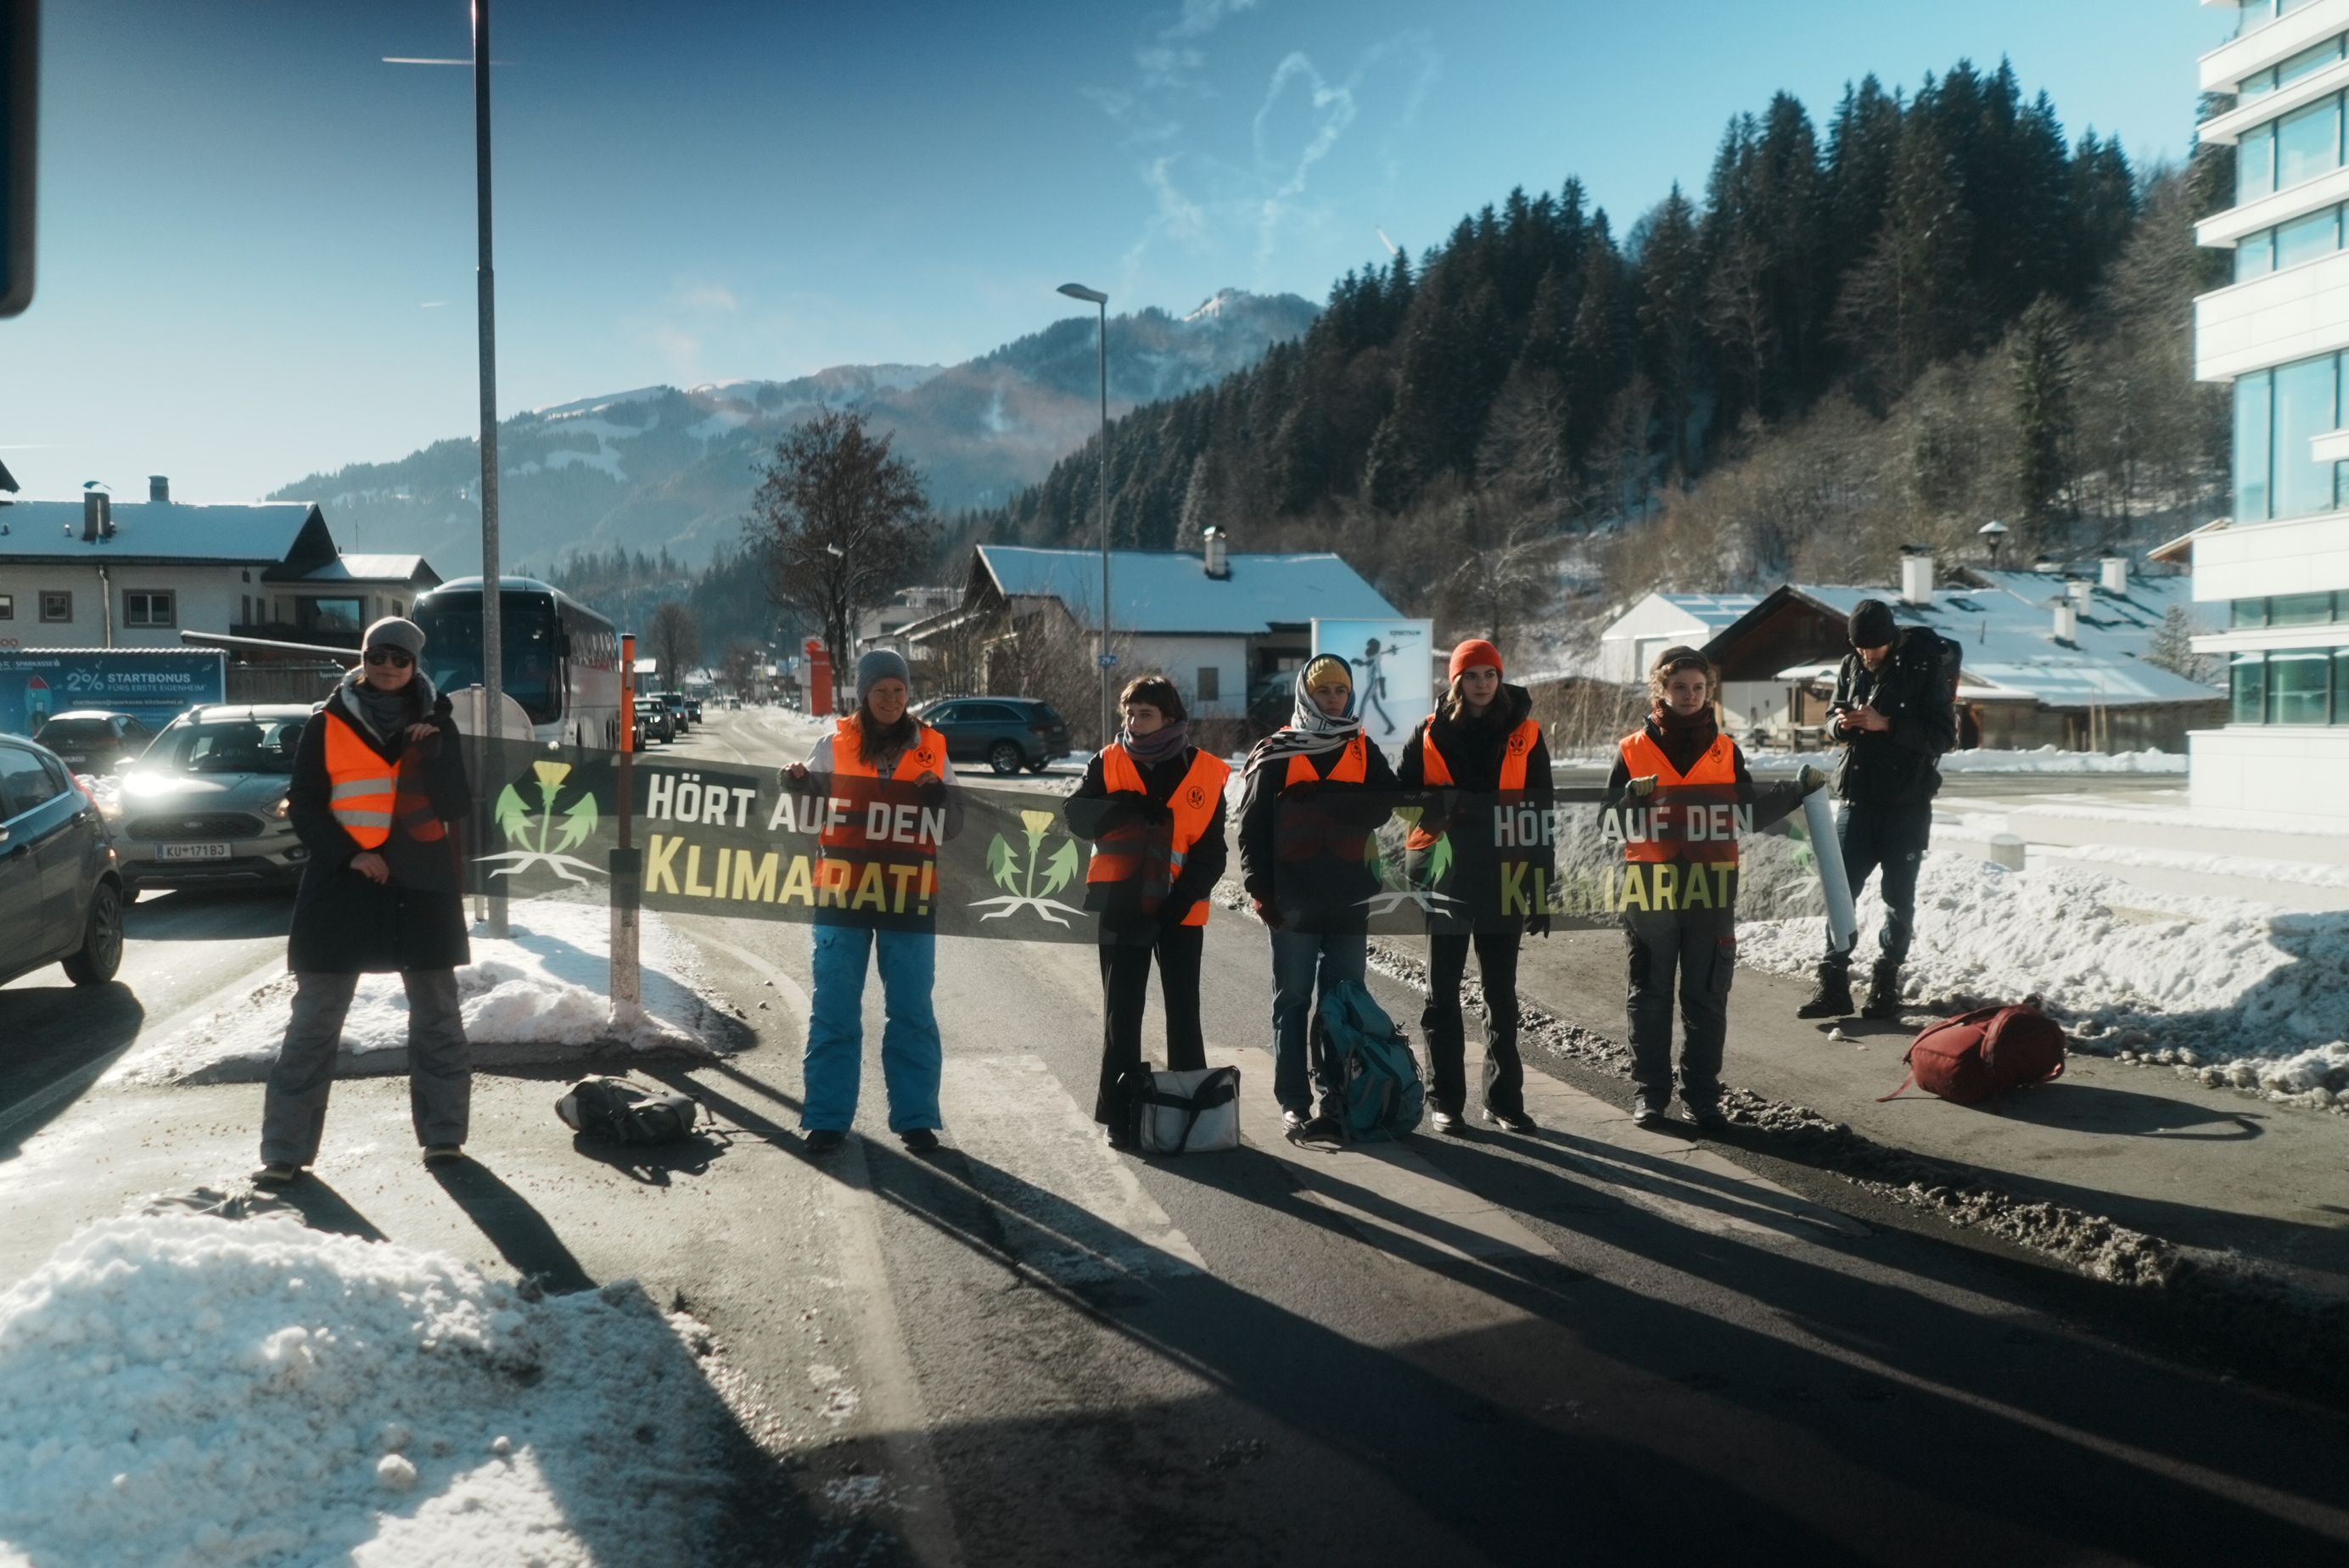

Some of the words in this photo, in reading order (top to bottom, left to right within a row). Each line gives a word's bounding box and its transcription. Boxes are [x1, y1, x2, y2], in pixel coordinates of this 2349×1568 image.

[67, 672, 104, 692] 2%
[108, 674, 191, 683] STARTBONUS
[108, 684, 130, 692] FÜRS
[647, 773, 755, 827] HÖRT
[767, 792, 851, 836] AUF
[866, 802, 945, 846] DEN
[1601, 807, 1671, 843] AUF
[1687, 804, 1753, 842] DEN
[645, 834, 933, 916] KLIMARAT!
